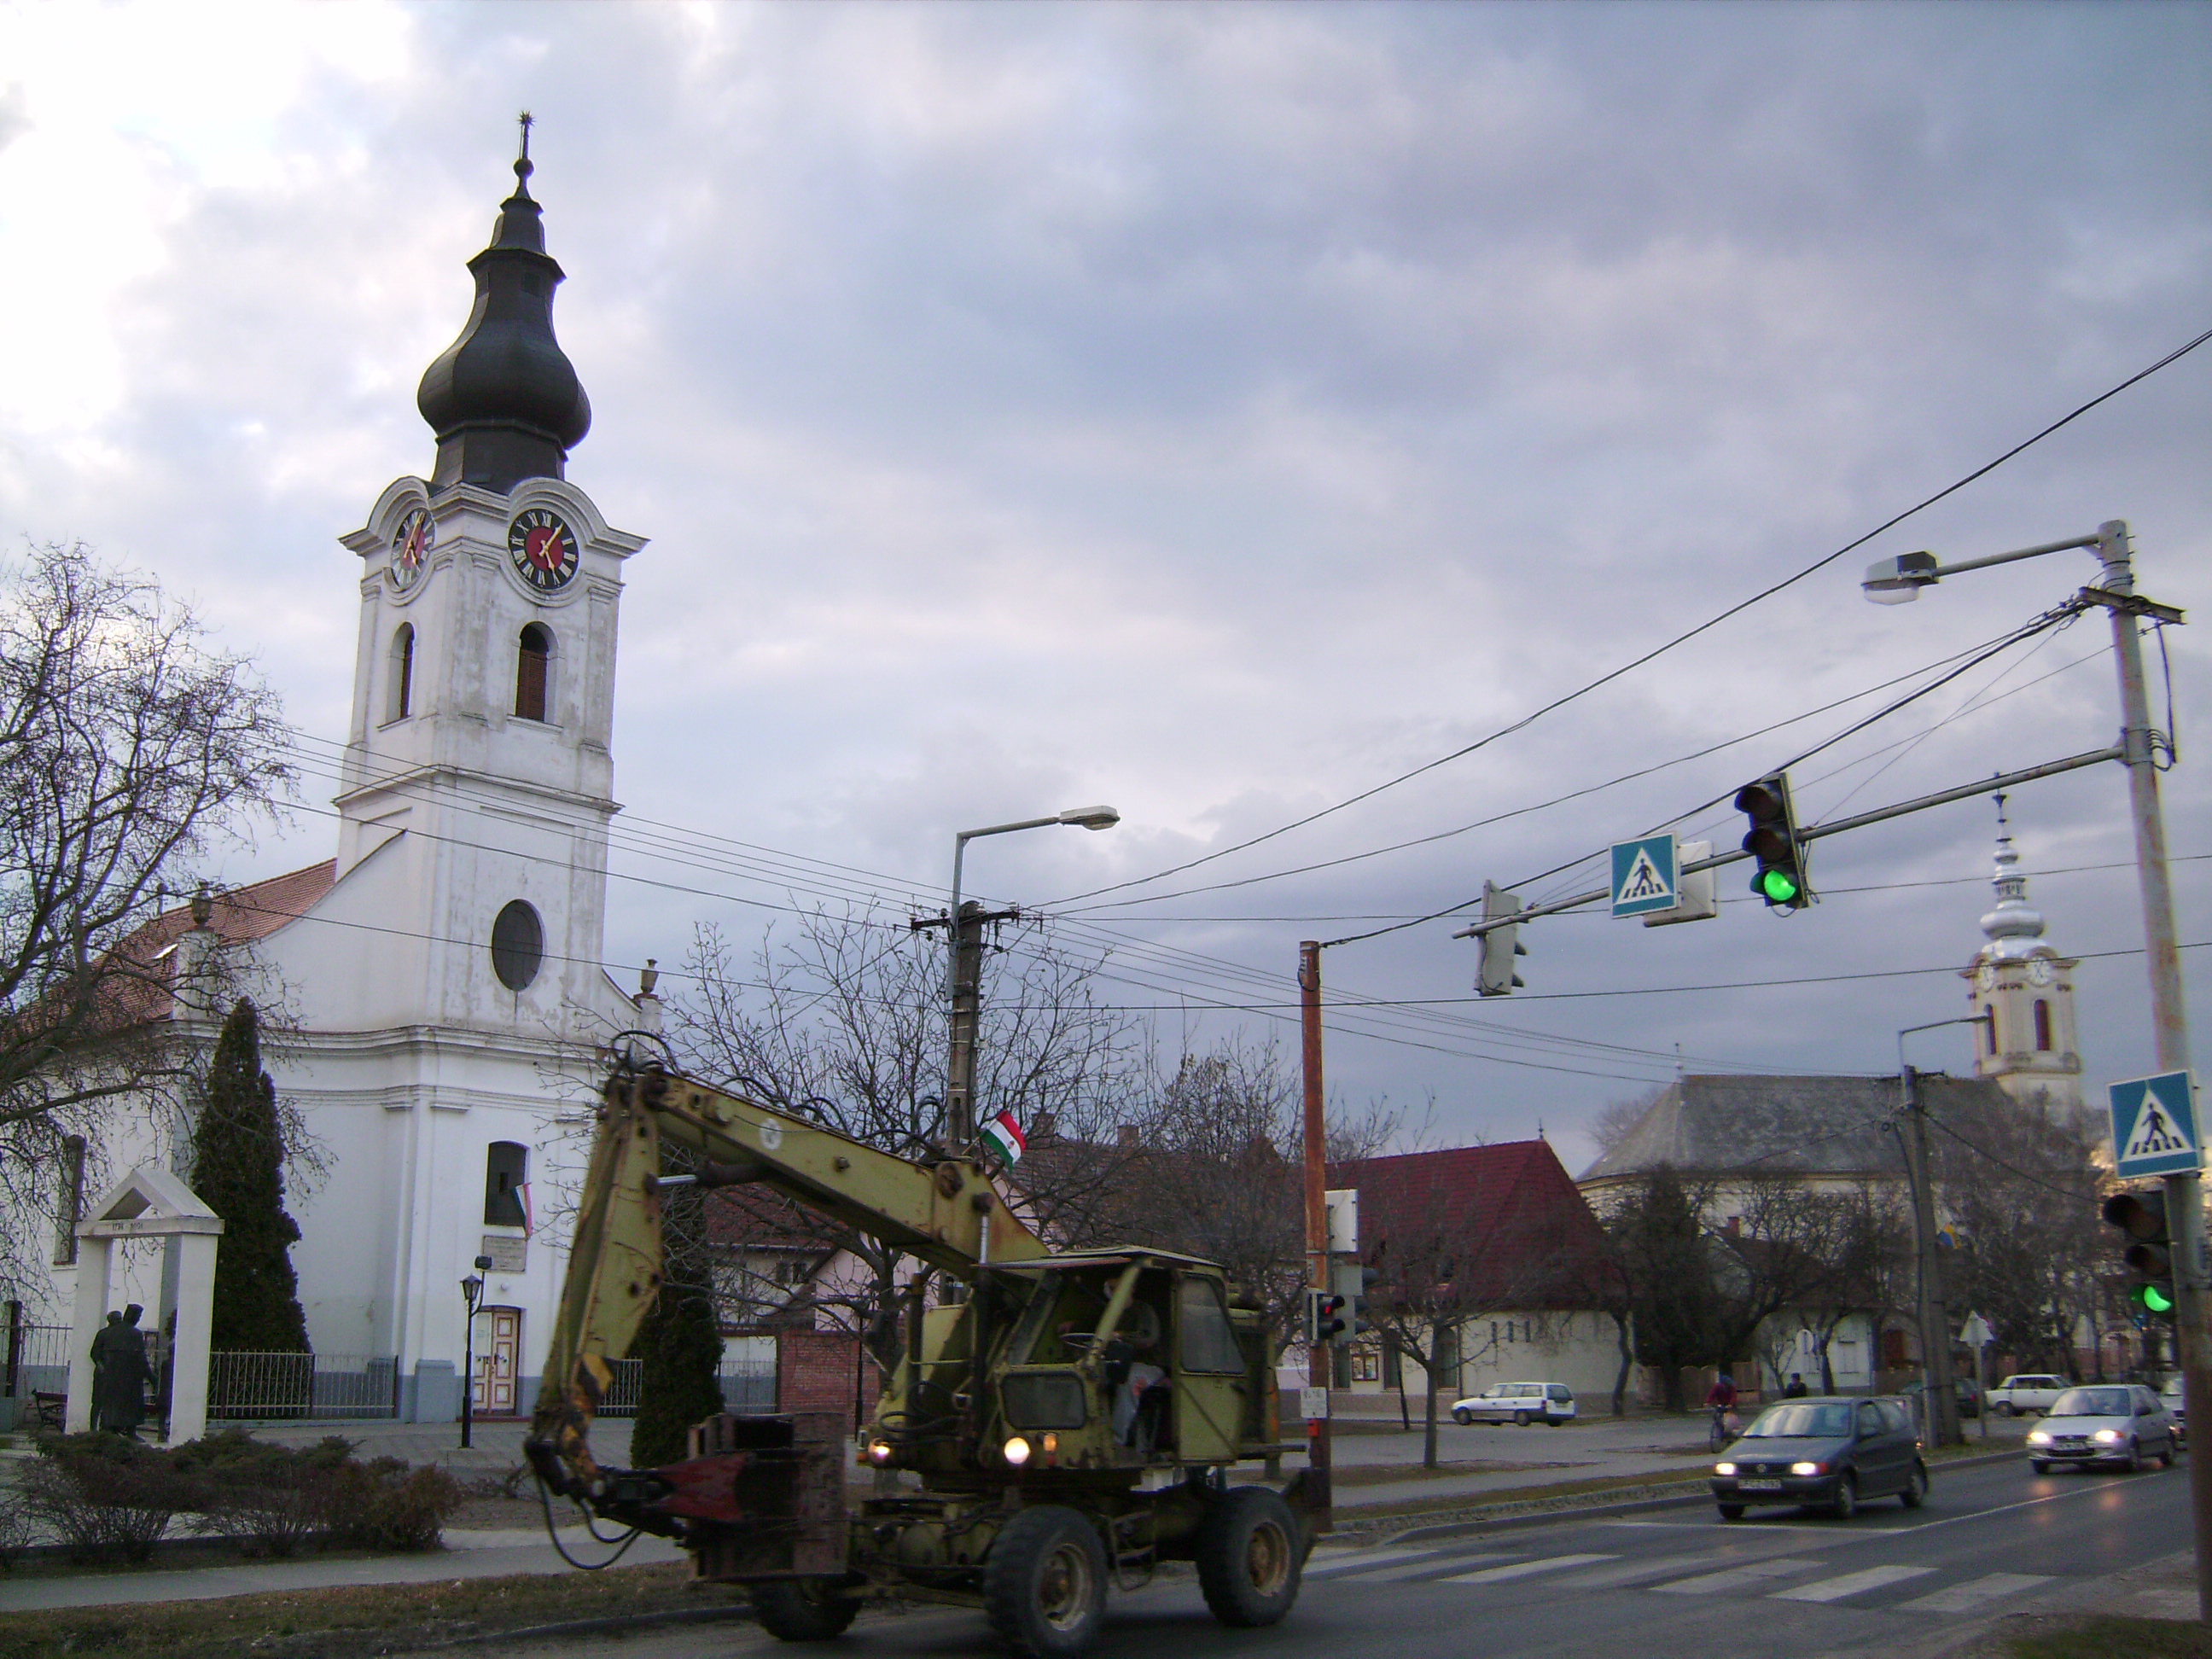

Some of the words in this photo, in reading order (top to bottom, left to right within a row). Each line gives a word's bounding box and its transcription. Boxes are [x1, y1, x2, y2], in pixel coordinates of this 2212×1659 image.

[527, 511, 539, 527] XI
[542, 512, 552, 528] XII
[516, 521, 529, 534] X
